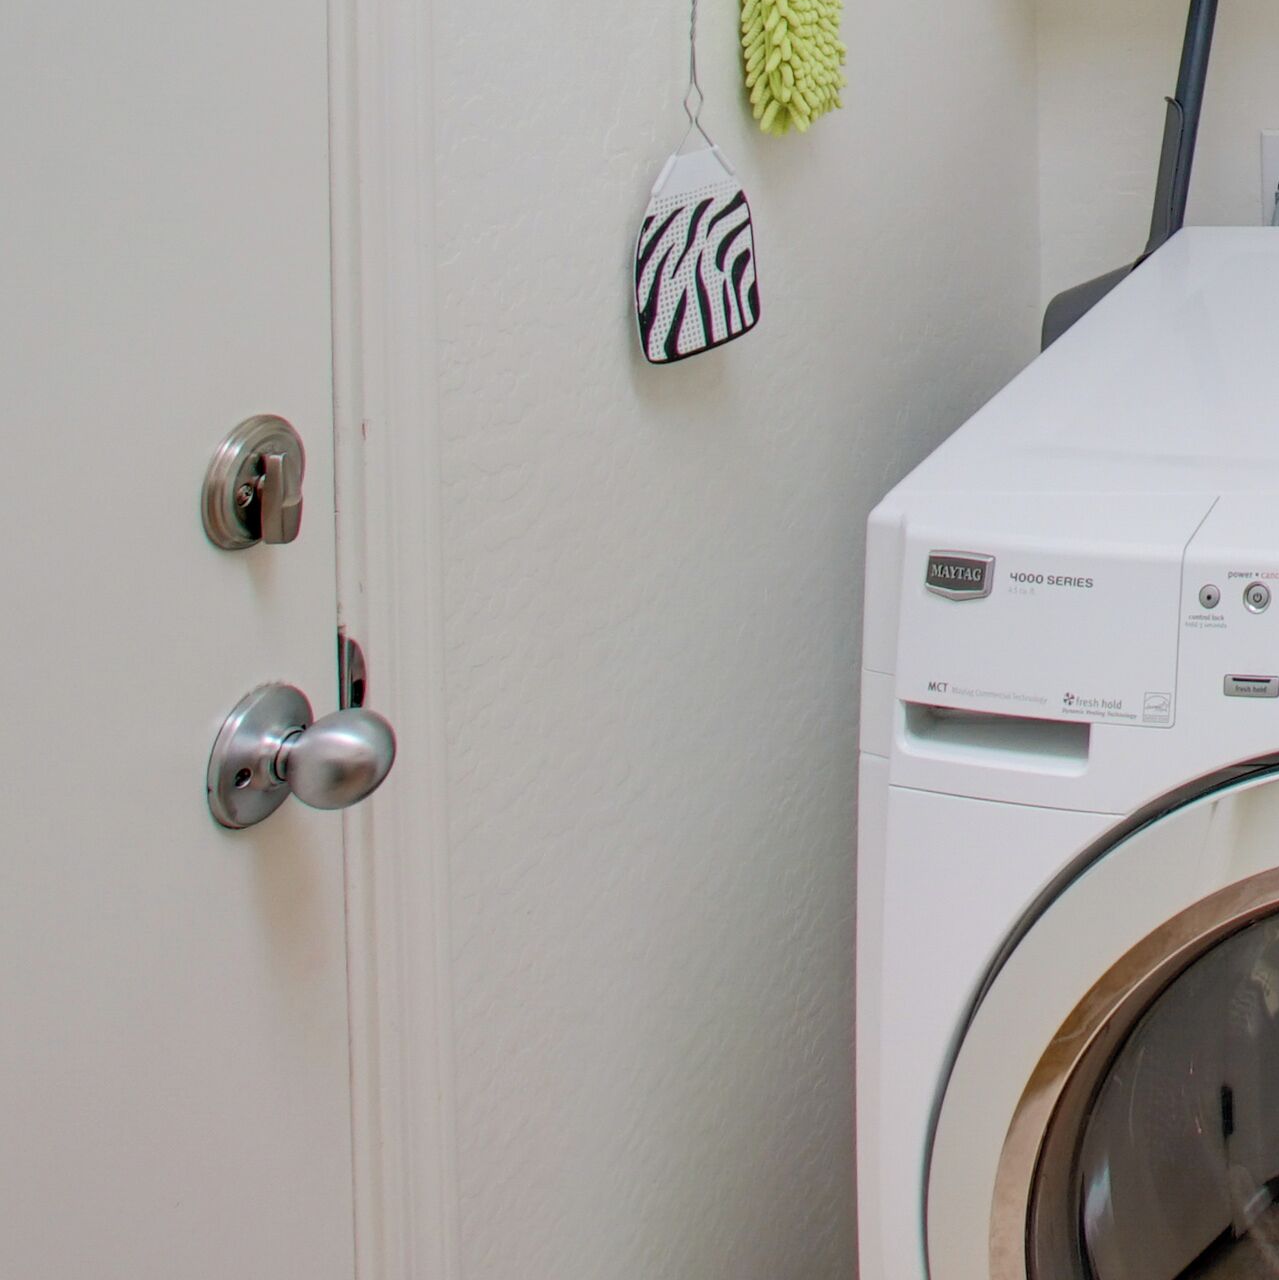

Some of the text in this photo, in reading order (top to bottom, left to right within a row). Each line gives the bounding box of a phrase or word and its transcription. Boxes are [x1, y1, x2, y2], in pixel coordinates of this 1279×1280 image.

[931, 564, 982, 582] MAYTAG
[1227, 570, 1253, 579] power
[1010, 573, 1094, 589] 4000 SERIES
[927, 681, 948, 693] MCT
[1075, 697, 1122, 710] fresh hold
